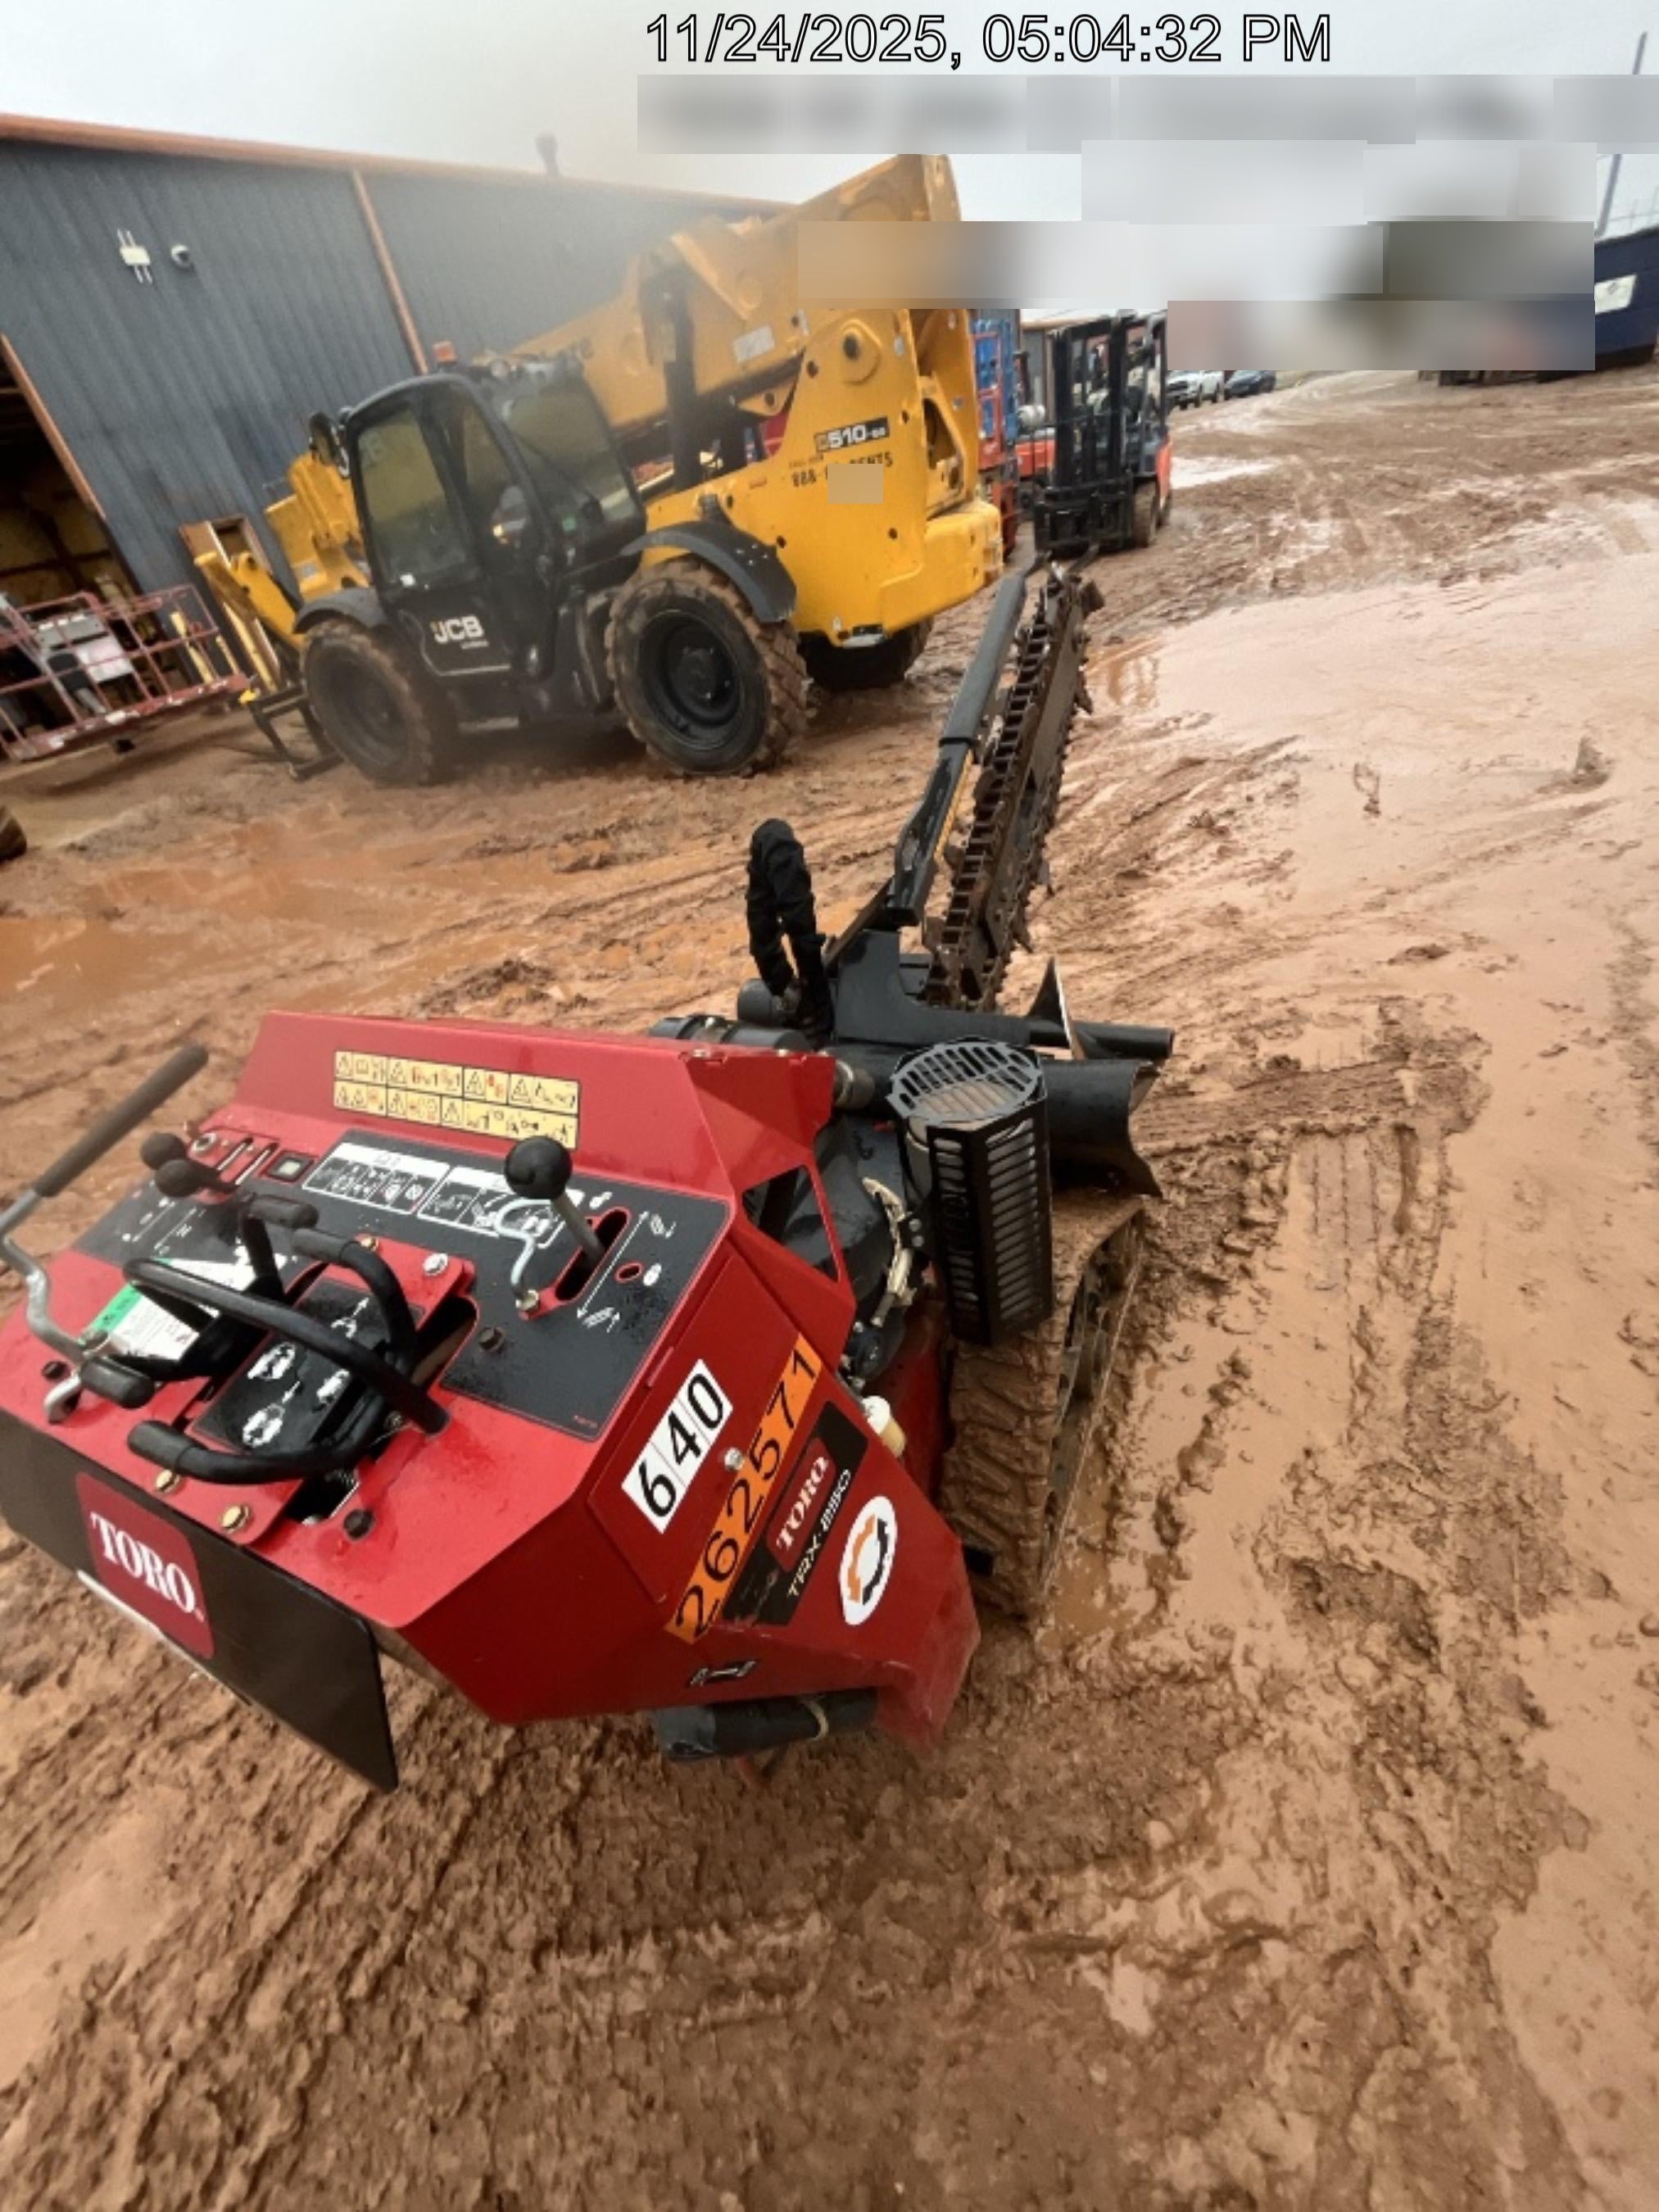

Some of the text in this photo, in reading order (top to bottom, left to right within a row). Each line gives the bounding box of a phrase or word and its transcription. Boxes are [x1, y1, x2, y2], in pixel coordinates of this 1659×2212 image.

[430, 615, 484, 644] JCB
[638, 1373, 724, 1517] 640
[676, 1349, 817, 1635] 262571
[776, 1456, 830, 1552] TORO
[90, 1511, 196, 1614] TORO
